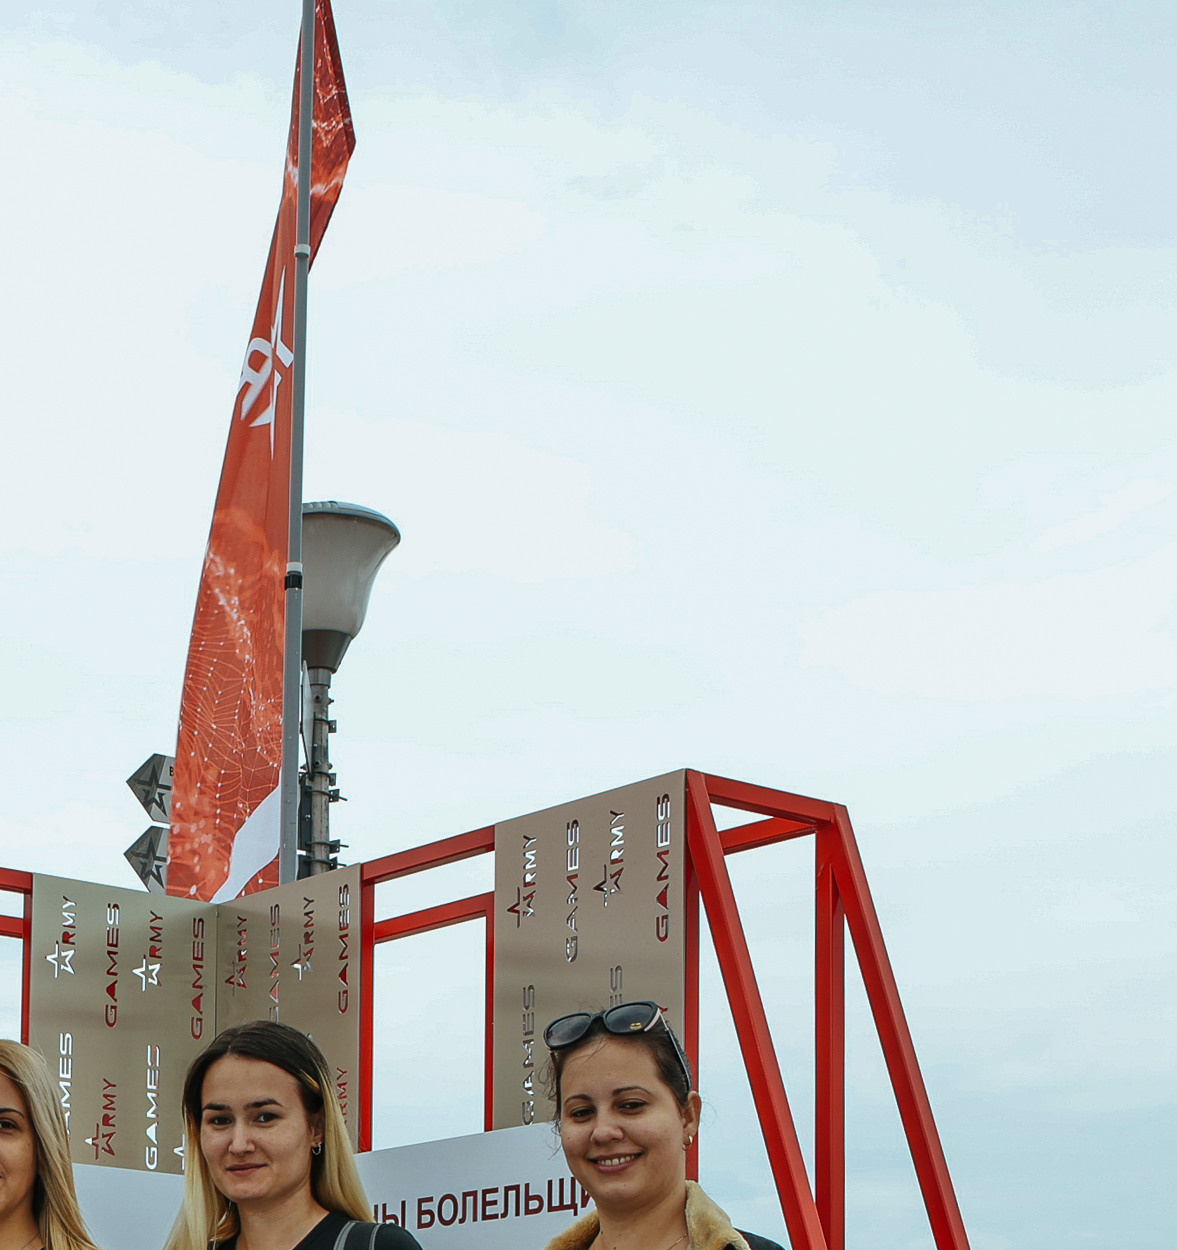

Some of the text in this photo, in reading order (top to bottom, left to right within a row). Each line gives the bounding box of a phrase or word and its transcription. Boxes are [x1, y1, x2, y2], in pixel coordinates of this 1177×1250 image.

[566, 818, 579, 963] GAMES
[656, 793, 671, 942] GAMES
[105, 902, 121, 1028] GAMES
[190, 917, 205, 1040] GAMES
[338, 883, 351, 1014] GAMES
[60, 1032, 72, 1135] AMES
[145, 1045, 160, 1171] GAMES
[522, 984, 536, 1126] GAMES
